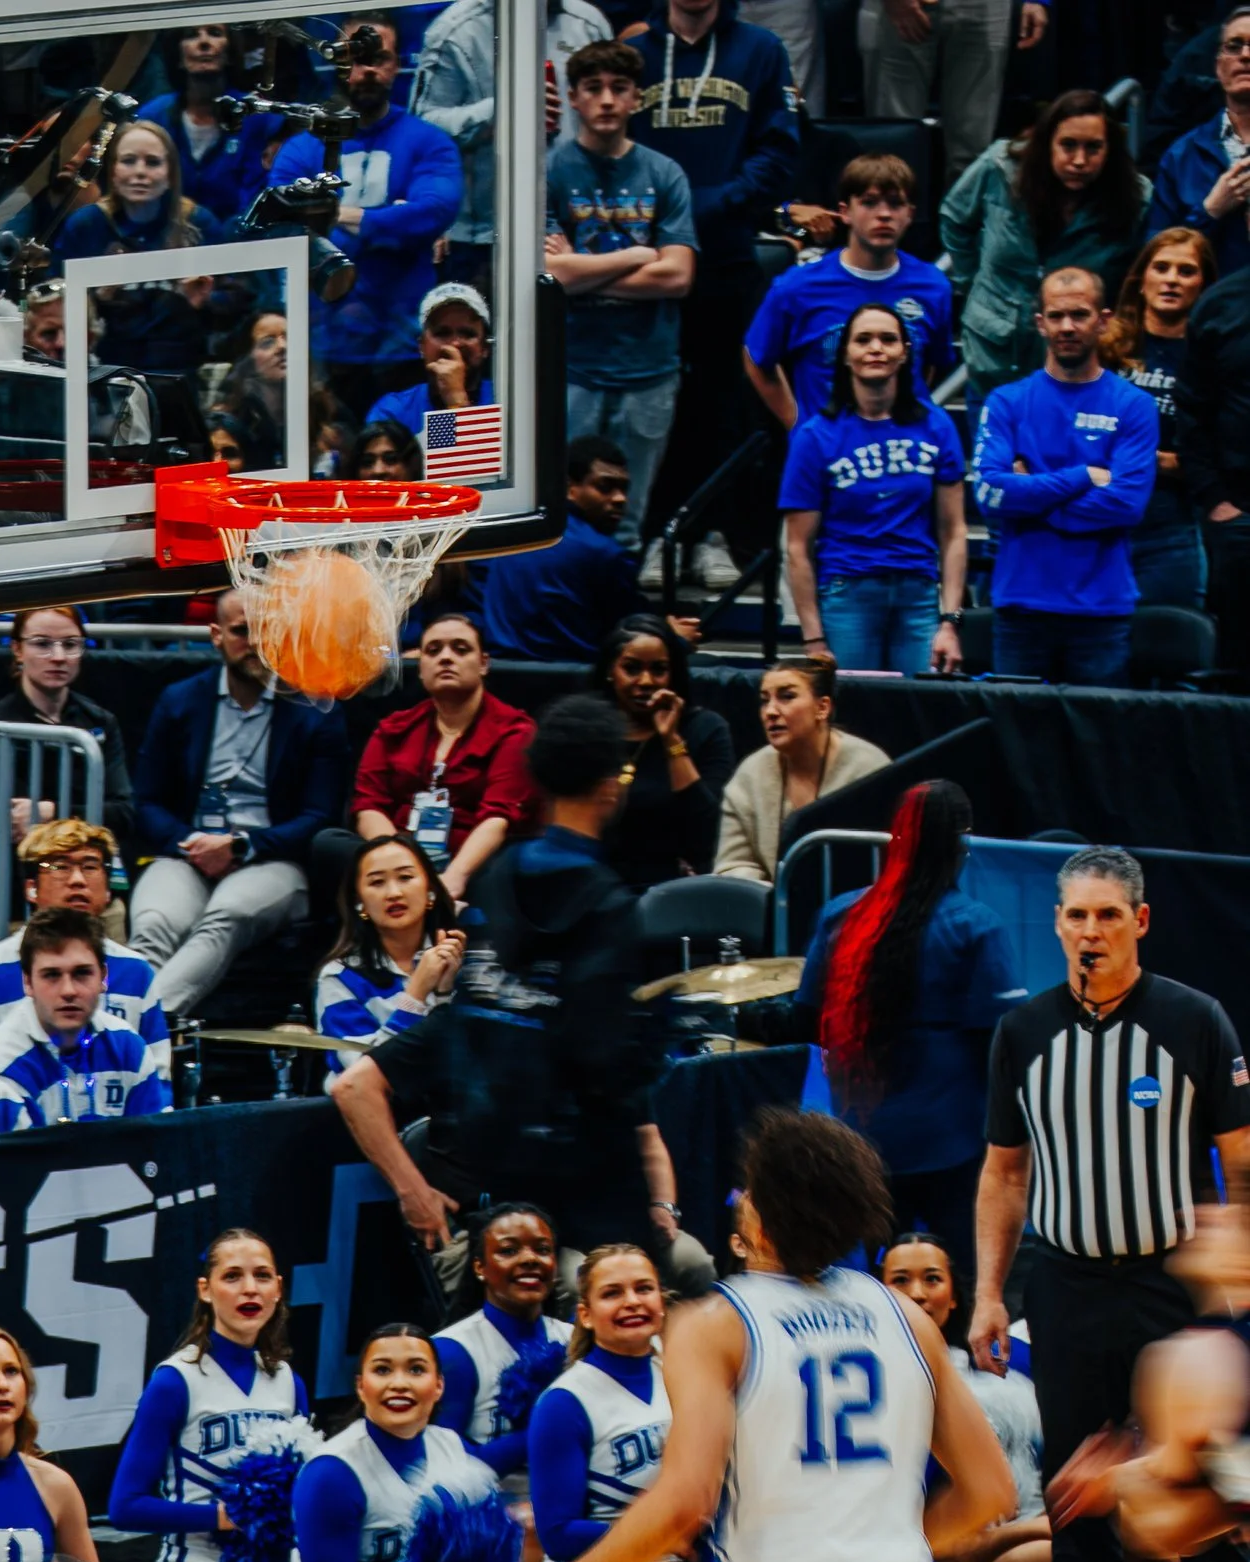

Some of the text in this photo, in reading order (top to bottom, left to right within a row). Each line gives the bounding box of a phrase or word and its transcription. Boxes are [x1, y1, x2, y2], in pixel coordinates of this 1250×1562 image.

[828, 439, 940, 489] DUKE
[796, 1350, 892, 1466] 12
[199, 1411, 288, 1459] DU
[613, 1424, 668, 1479] DU
